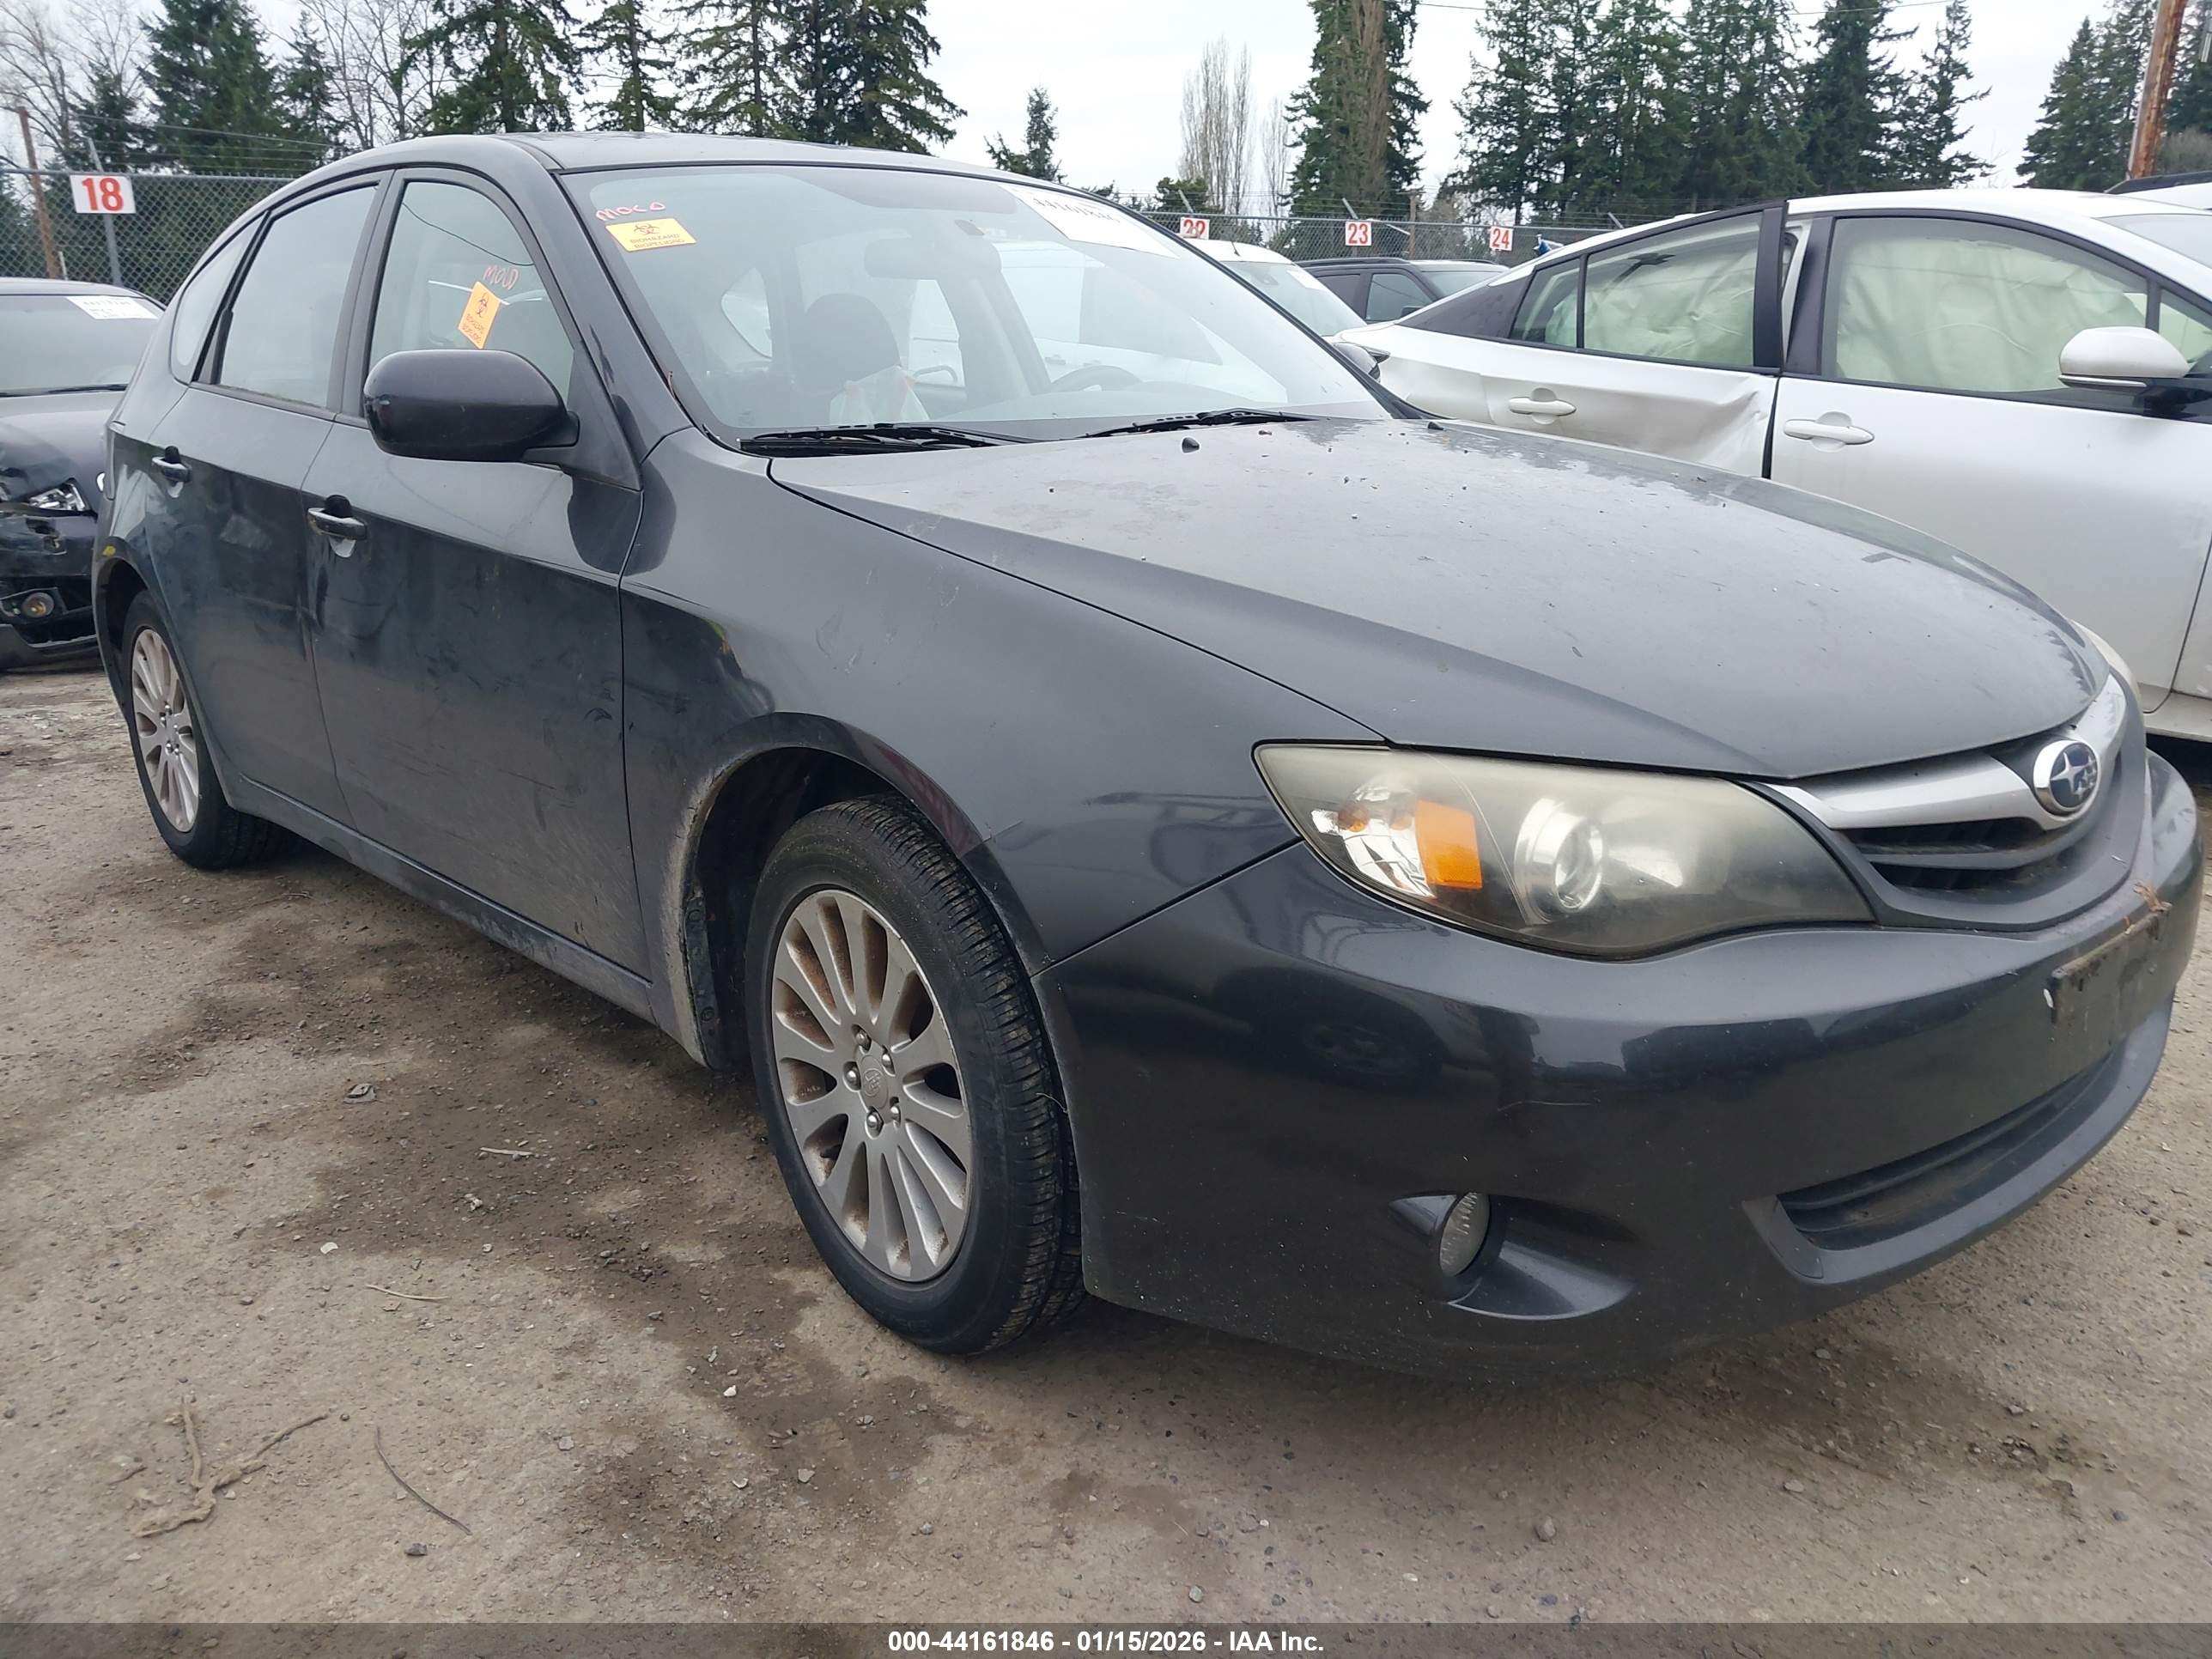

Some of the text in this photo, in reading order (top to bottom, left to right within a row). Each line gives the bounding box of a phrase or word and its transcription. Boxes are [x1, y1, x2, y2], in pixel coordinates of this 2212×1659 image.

[82, 177, 125, 212] 18
[1347, 222, 1369, 245] 23
[1492, 228, 1510, 249] 24
